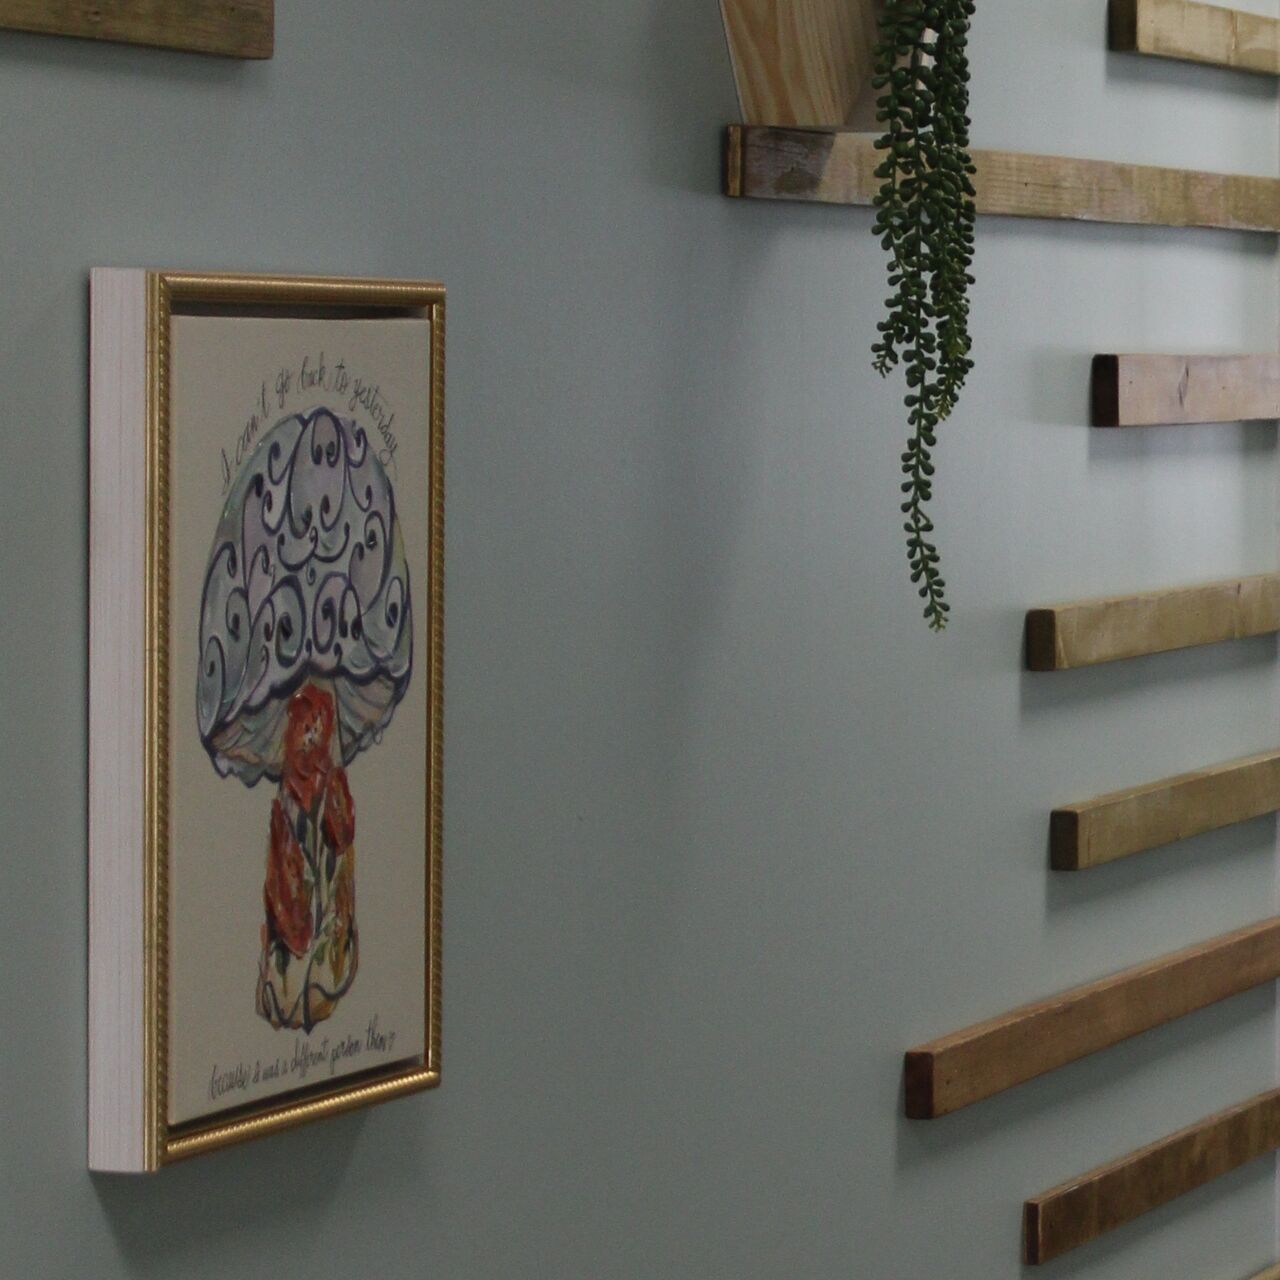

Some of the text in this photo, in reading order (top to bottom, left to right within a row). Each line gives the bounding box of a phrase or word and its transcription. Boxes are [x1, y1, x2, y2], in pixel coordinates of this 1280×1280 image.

[275, 368, 291, 409] go
[297, 351, 328, 393] back
[335, 358, 351, 394] to
[349, 379, 397, 466] yesterday
[290, 1036, 328, 1079] different
